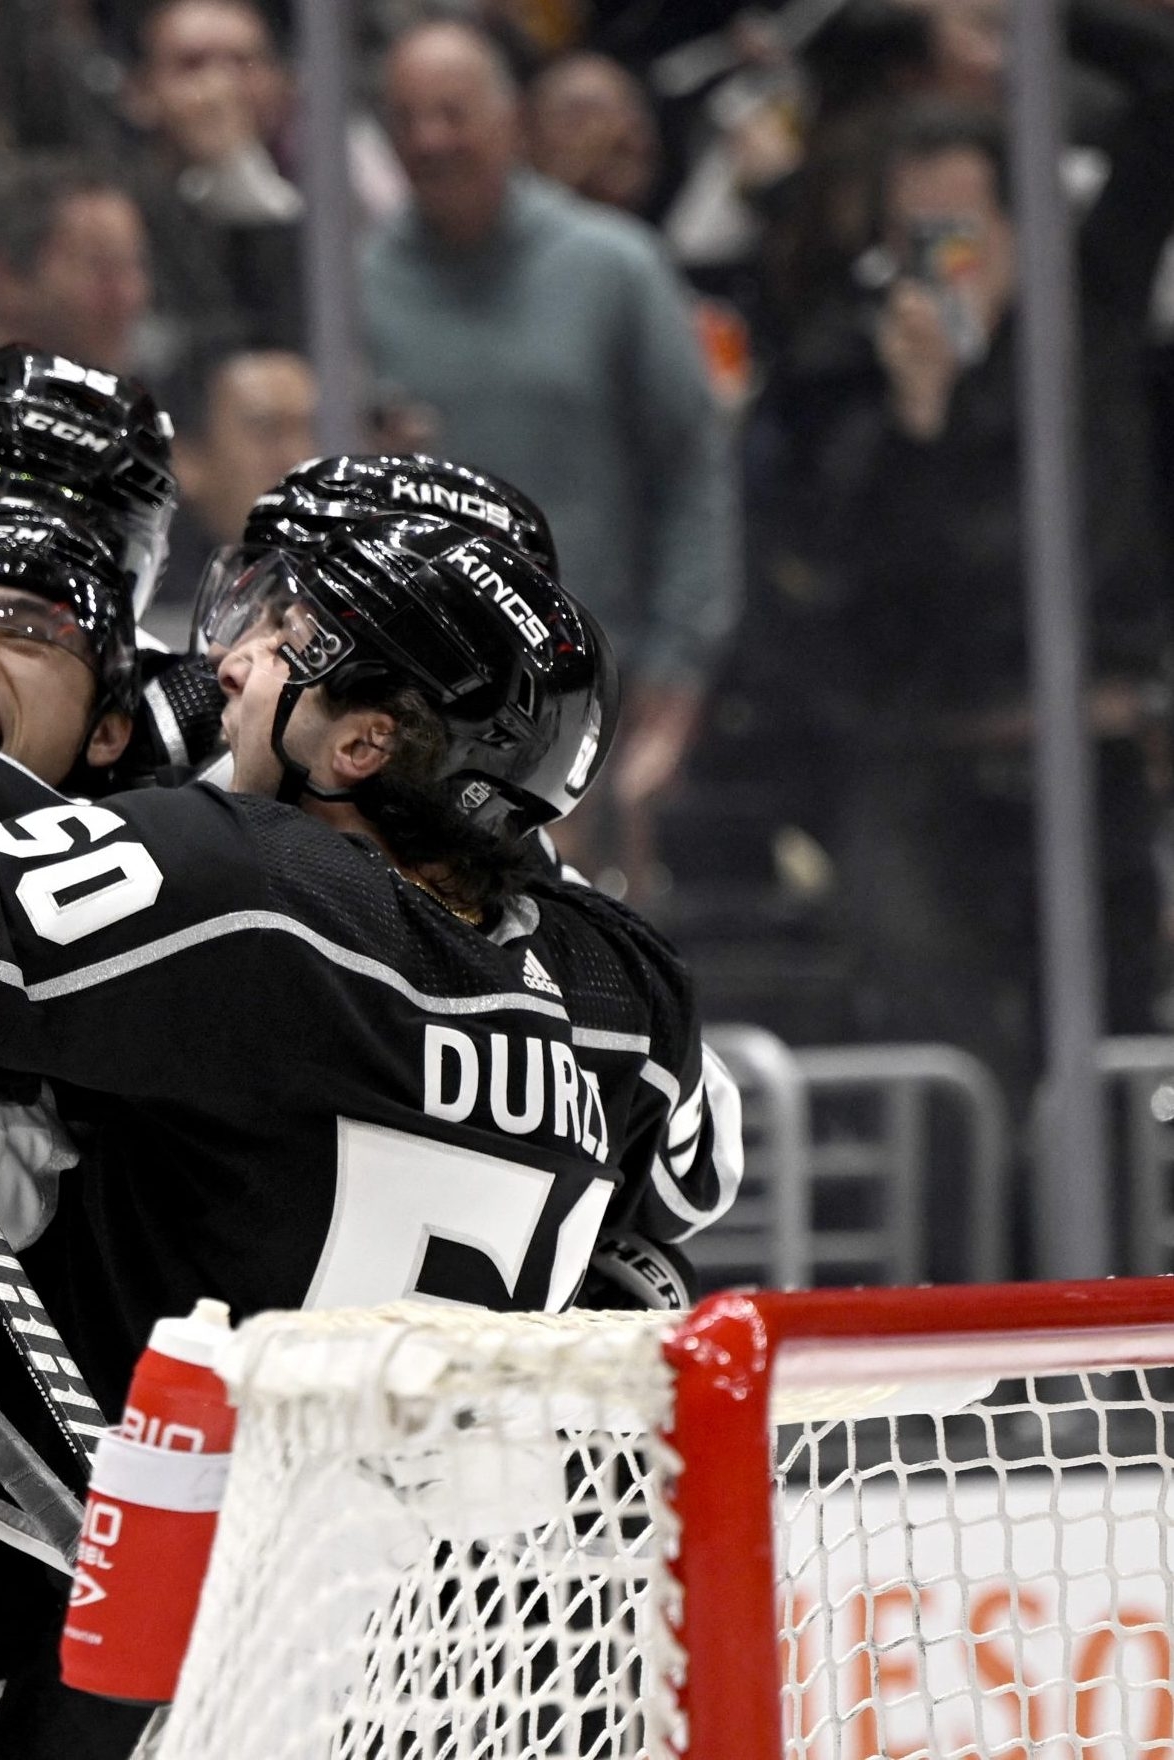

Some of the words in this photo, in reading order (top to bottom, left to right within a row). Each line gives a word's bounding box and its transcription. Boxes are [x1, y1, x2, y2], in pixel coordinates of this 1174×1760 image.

[23, 409, 110, 453] CCM
[392, 479, 512, 533] KINGS
[446, 546, 551, 649] KINGS
